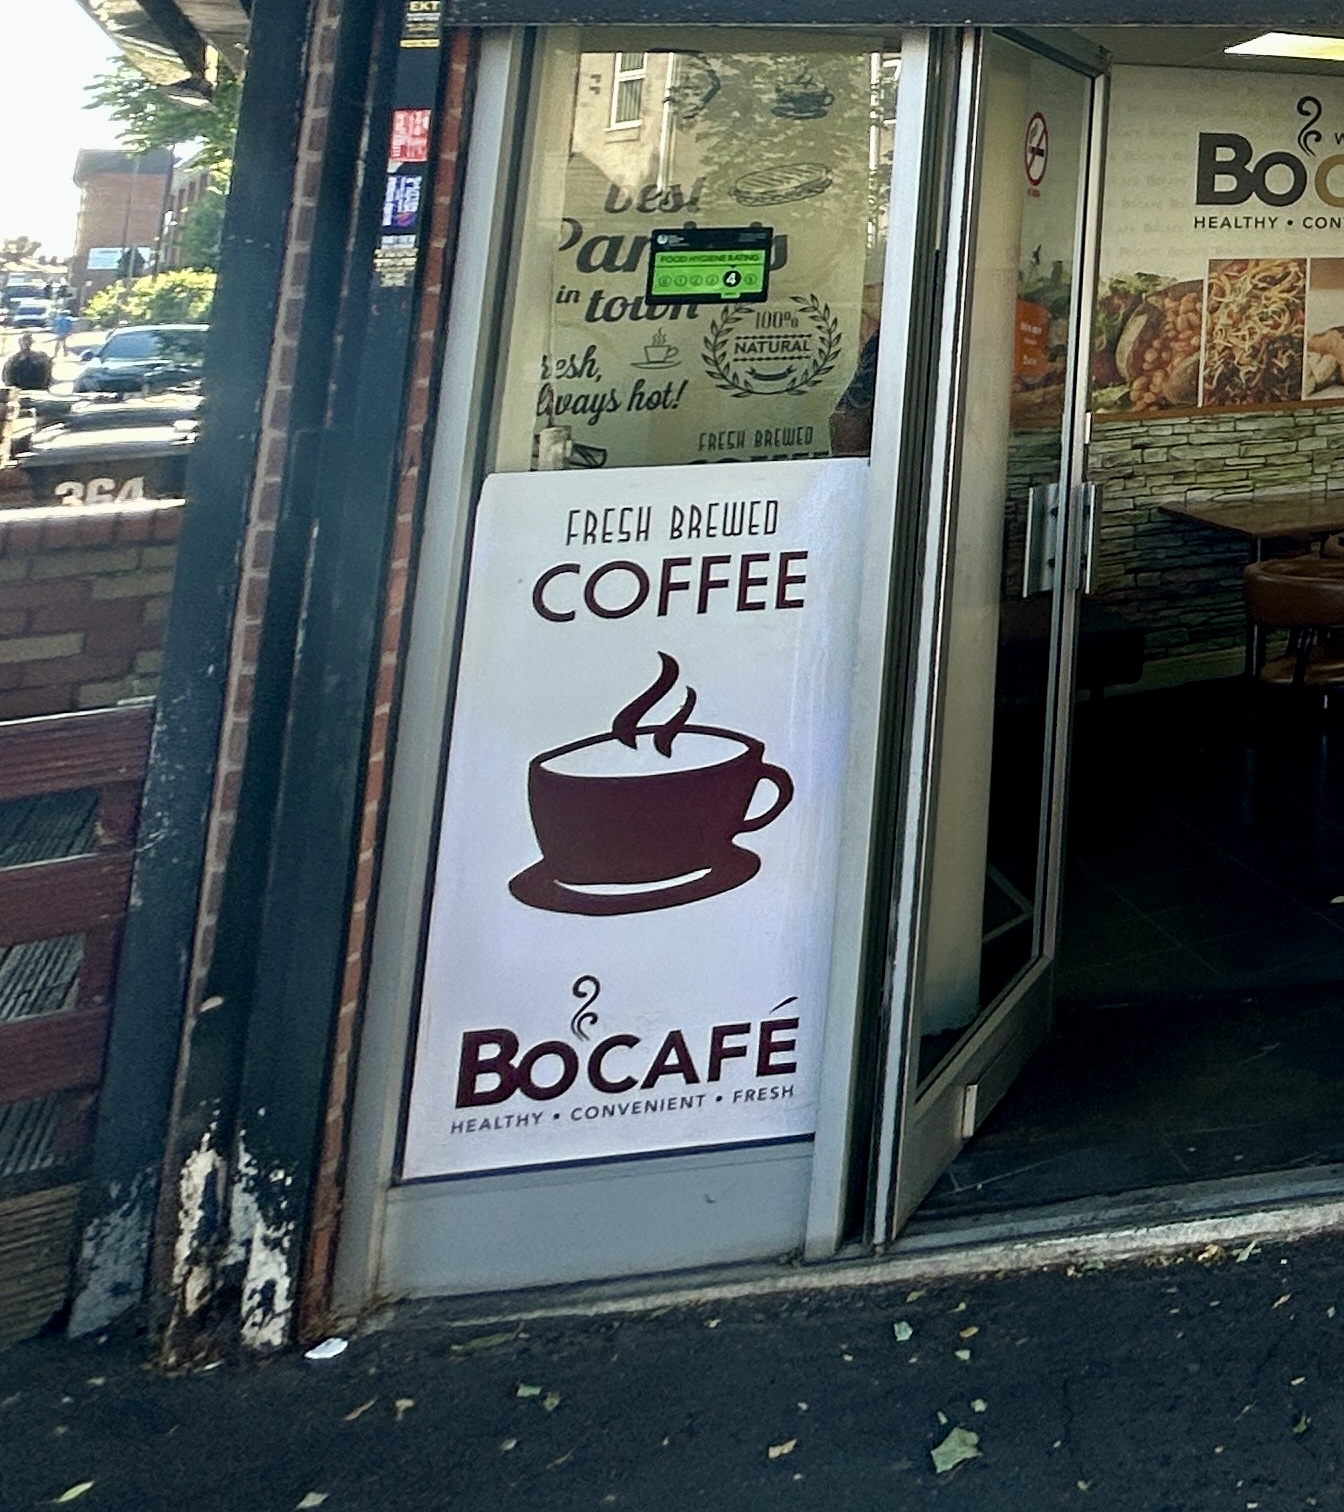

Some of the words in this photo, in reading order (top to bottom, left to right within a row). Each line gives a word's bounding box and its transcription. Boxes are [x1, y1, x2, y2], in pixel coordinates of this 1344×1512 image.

[1194, 216, 1279, 230] HEALTHY
[725, 272, 737, 285] 4
[556, 286, 579, 304] in
[734, 339, 813, 354] NATURAL
[627, 378, 690, 412] hot!
[698, 429, 746, 451] FRESH
[754, 426, 814, 448] BREWED
[566, 505, 652, 546] FRESH
[670, 500, 779, 540] BREWED
[532, 551, 809, 622] COFFEE
[451, 1112, 544, 1135] HEALTHY
[570, 1094, 706, 1122] CONVENIENT
[732, 1085, 795, 1104] FRESH
